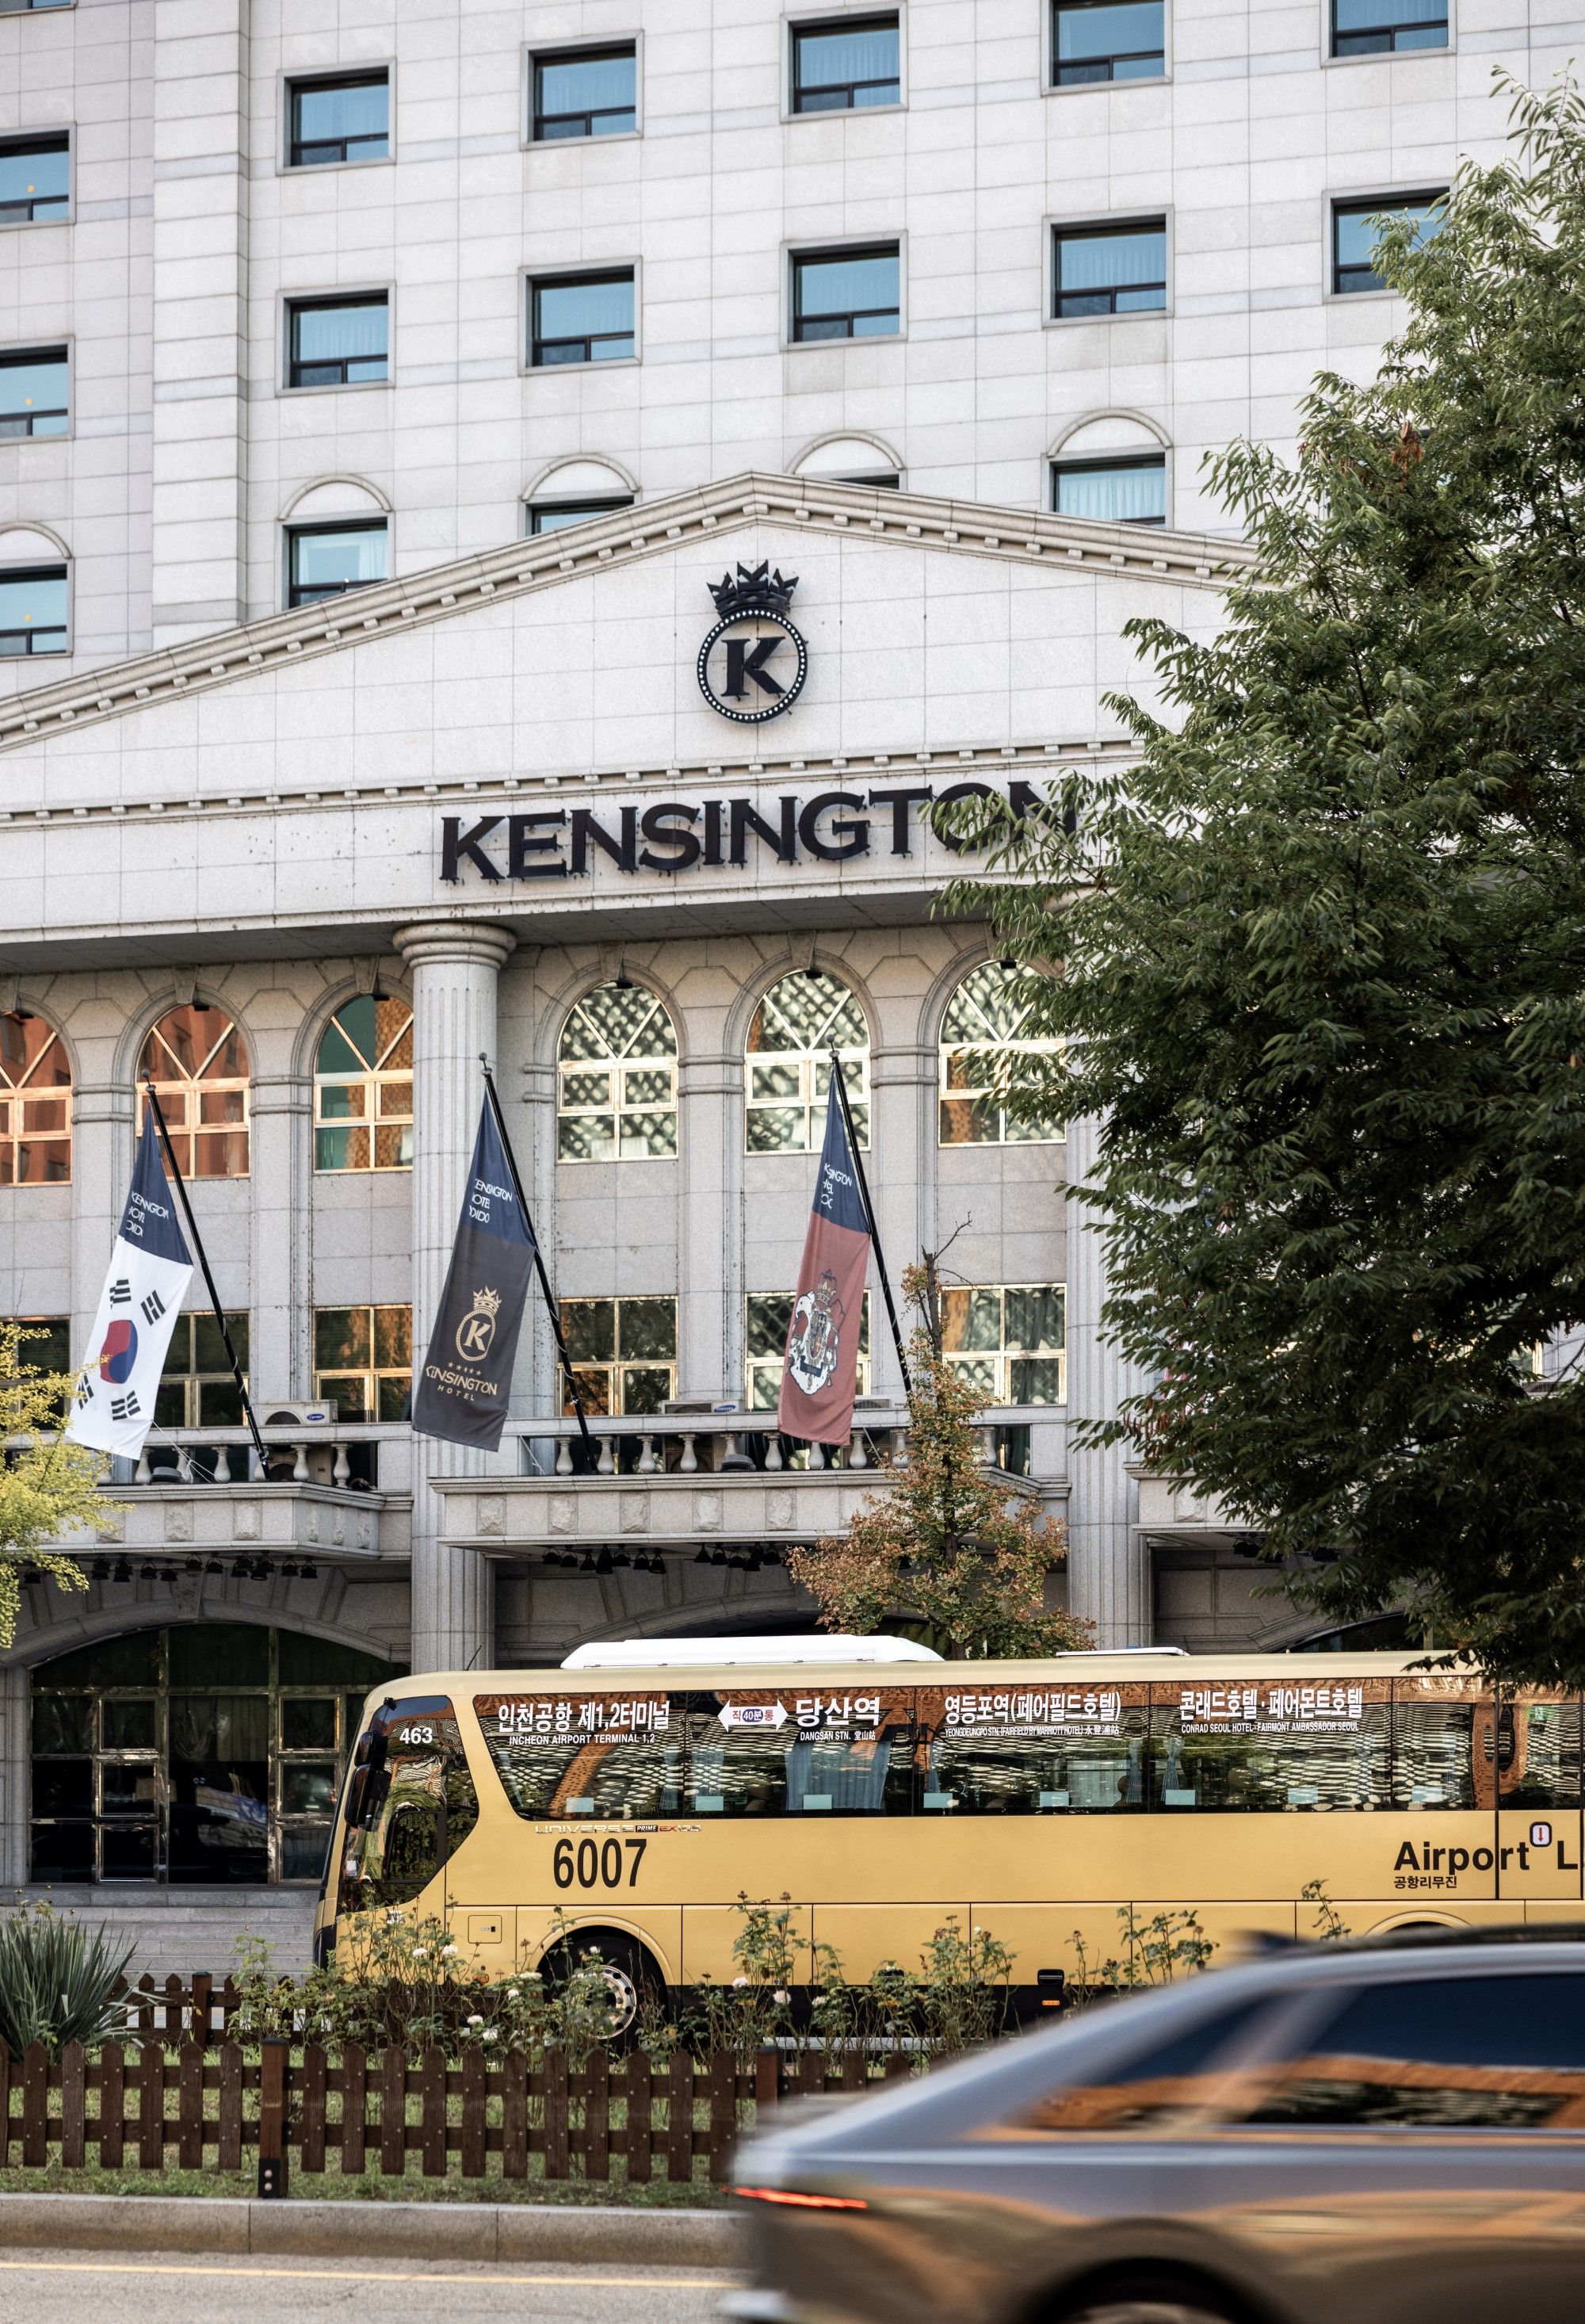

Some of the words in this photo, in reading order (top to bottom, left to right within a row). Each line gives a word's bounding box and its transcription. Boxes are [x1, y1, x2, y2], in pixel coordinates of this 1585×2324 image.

[720, 635, 787, 698] K
[439, 779, 1078, 884] KENSINGTON
[463, 1319, 492, 1351] K
[437, 1385, 475, 1401] HOTEL
[498, 1702, 572, 1733] 인천공항
[578, 1700, 670, 1732] 제1,2터미널
[796, 1696, 880, 1727] 당산역
[399, 1727, 433, 1745] 463
[800, 1731, 834, 1741] DANGSAN
[835, 1730, 851, 1741] STN.
[1037, 1725, 1064, 1736] MARRIOTT
[1181, 1723, 1208, 1733] CONRAD
[1210, 1722, 1231, 1733] SEOUL
[1291, 1722, 1336, 1732] AMBASSADOR
[1338, 1721, 1359, 1731] SEOUL
[509, 1734, 549, 1745] INCHEON
[552, 1733, 592, 1744] AIRPORT
[594, 1733, 640, 1744] TERMINAL
[642, 1733, 655, 1744] 1,2
[535, 1825, 634, 1833] UNIVERSE
[553, 1838, 647, 1889] 6007
[1393, 1841, 1530, 1875] Airport
[1393, 1875, 1457, 1889] 공항리무진
